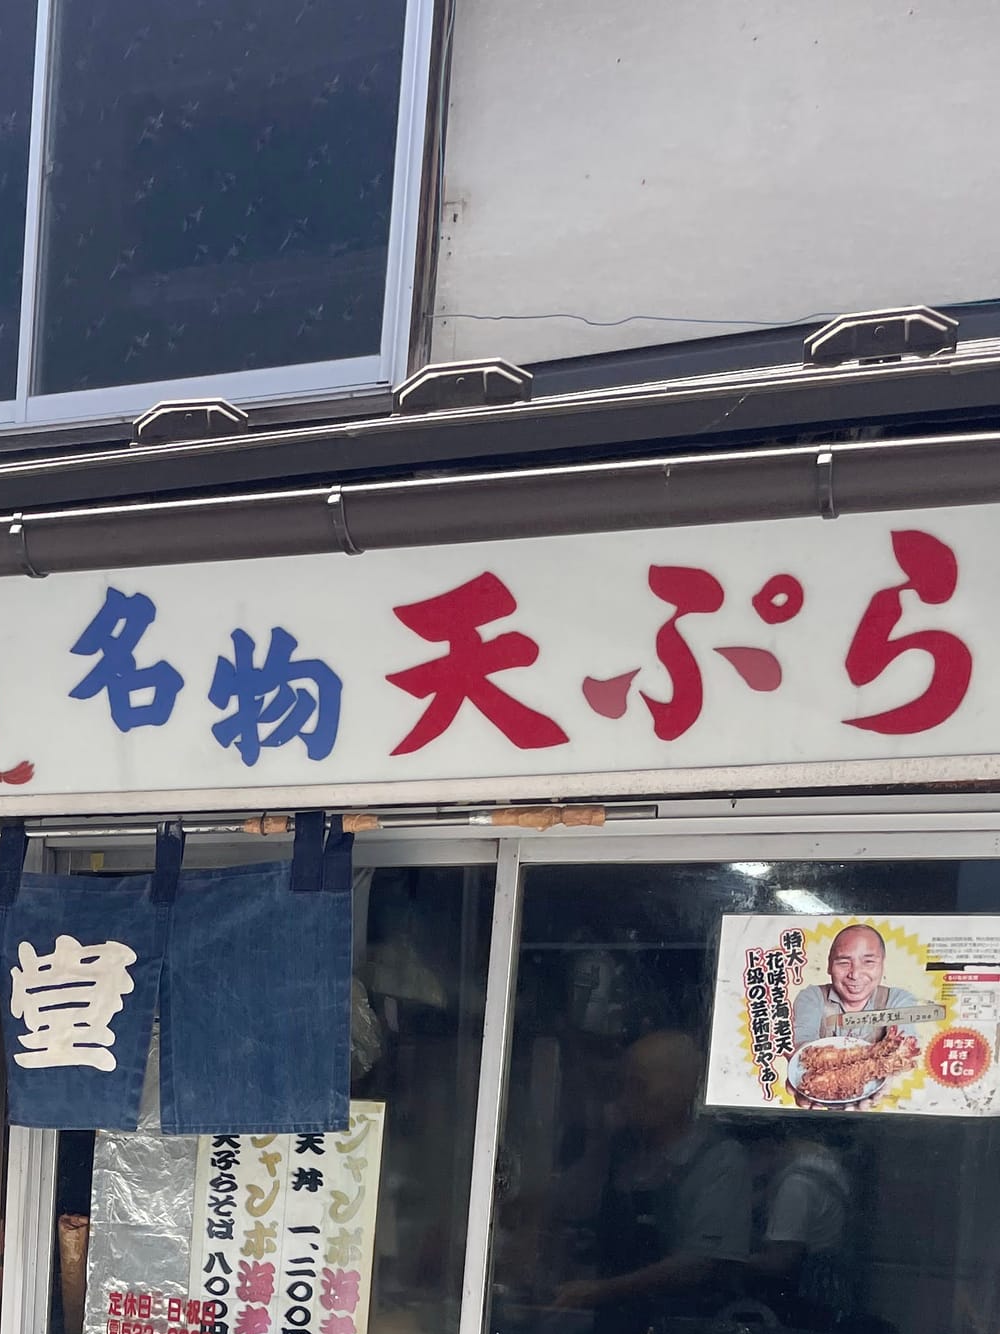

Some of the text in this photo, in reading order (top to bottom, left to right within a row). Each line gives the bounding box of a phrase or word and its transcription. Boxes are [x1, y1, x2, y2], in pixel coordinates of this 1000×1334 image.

[69, 587, 343, 766] 名物
[387, 530, 973, 756] 天ぷら
[766, 952, 794, 1055] 花咲き海老天
